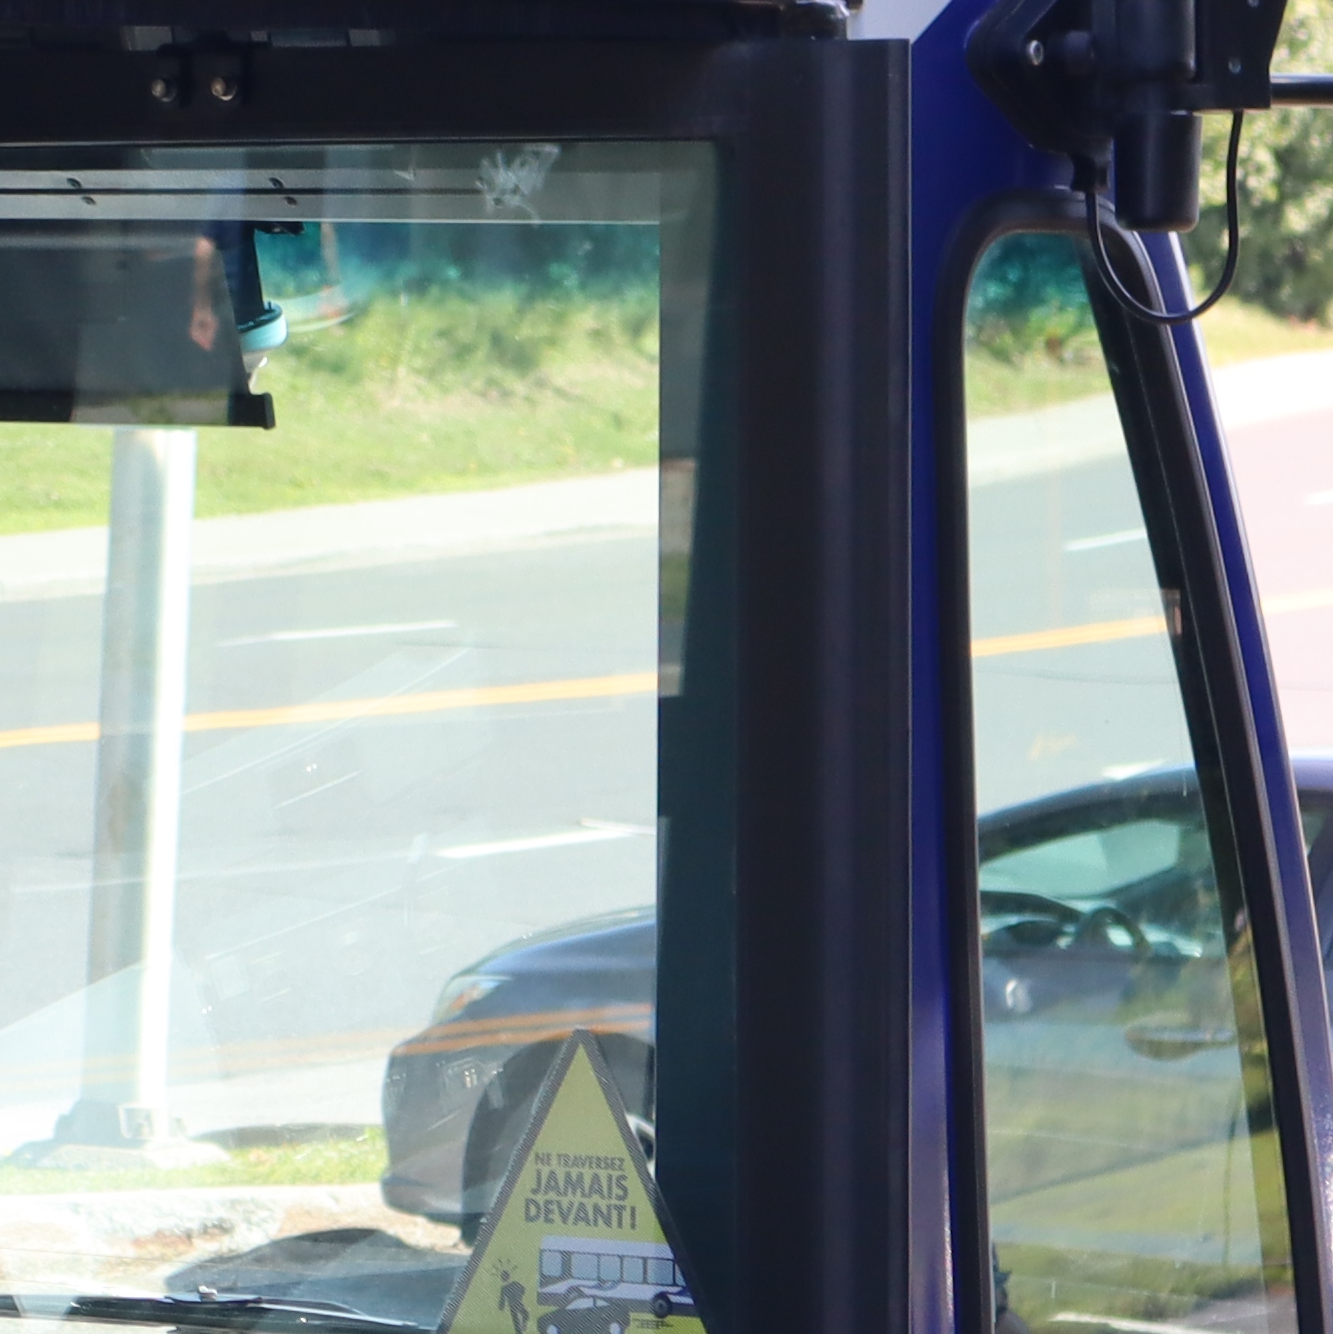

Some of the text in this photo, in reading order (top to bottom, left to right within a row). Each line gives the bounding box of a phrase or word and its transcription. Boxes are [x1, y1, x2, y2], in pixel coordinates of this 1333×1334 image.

[534, 1152, 625, 1172] NE TRAVERSEZ
[530, 1168, 629, 1202] JAMAIS
